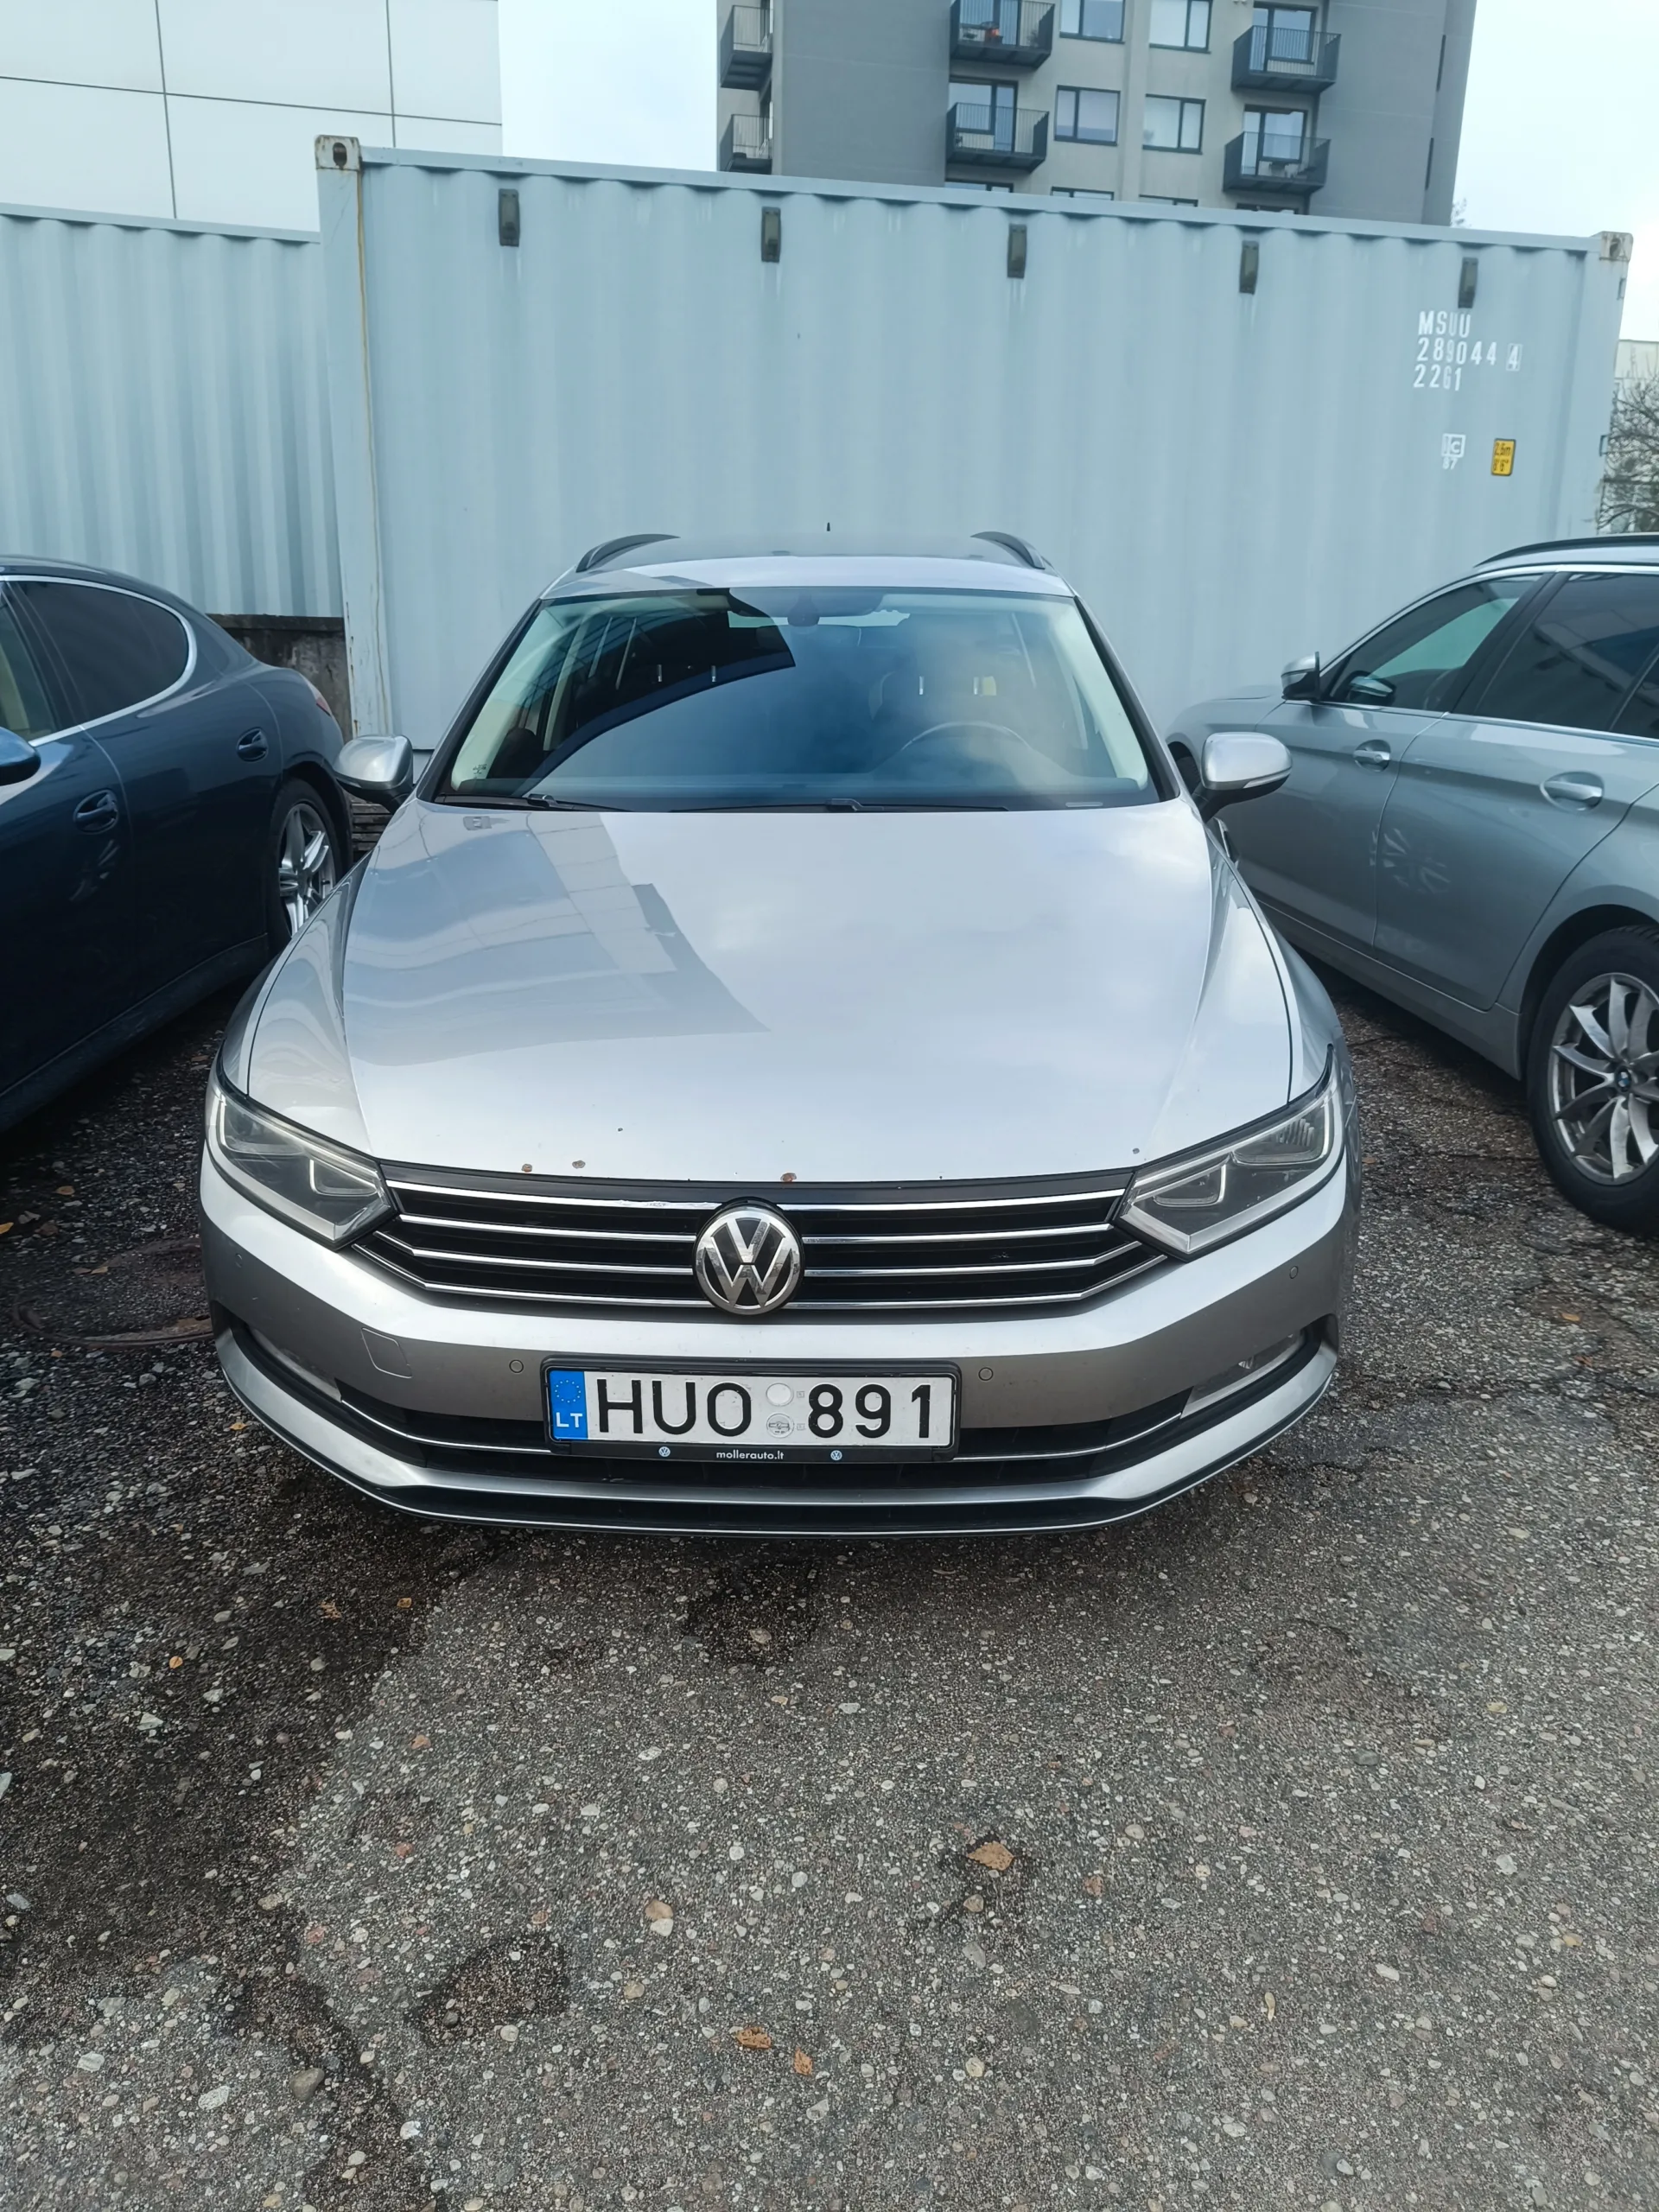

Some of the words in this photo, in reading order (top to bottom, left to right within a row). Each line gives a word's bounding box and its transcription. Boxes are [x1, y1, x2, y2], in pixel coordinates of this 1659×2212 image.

[1418, 310, 1471, 338] MSUU
[1416, 337, 1497, 365] 289044
[556, 1412, 583, 1428] LT
[597, 1378, 752, 1437] HUO
[808, 1382, 932, 1439] 891
[715, 1449, 785, 1460] mollerauto.lt
